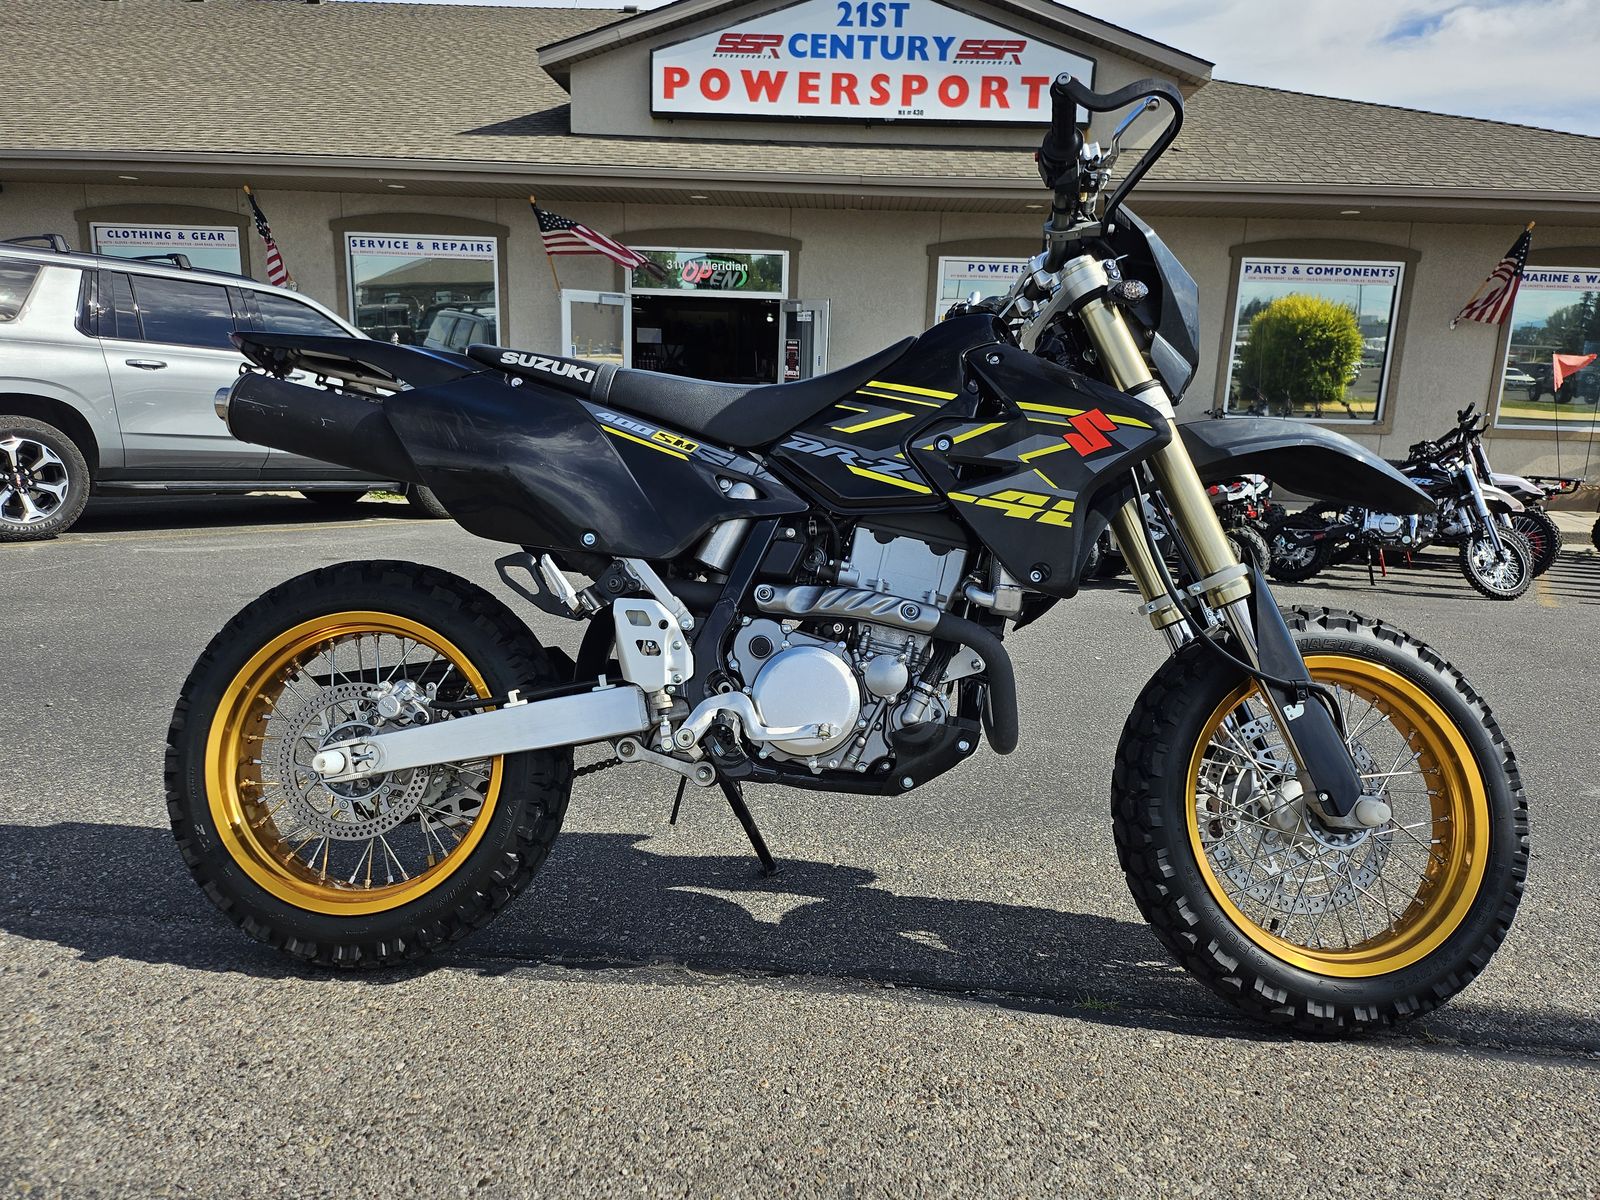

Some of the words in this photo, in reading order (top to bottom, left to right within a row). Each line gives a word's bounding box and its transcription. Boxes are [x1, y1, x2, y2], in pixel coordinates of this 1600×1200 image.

[837, 1, 910, 28] 21ST
[715, 33, 784, 59] SSR
[788, 33, 956, 61] CENTURY
[955, 39, 1027, 65] SSR
[664, 67, 1079, 110] POWERSPORT
[107, 230, 172, 240] CLOTHING
[177, 231, 185, 240] &
[191, 232, 225, 241] GEAR
[352, 239, 409, 250] SERVICE
[416, 241, 424, 250] &
[432, 242, 492, 252] REPAIRS
[666, 260, 684, 270] 310
[703, 260, 748, 271] Meridian
[680, 262, 740, 289] OPEN
[1245, 265, 1287, 275] PARTS
[1292, 266, 1300, 275] &
[1306, 266, 1395, 278] COMPONENTS
[1521, 273, 1569, 283] MARINE
[1572, 275, 1580, 283] &
[1586, 275, 1600, 283] W
[500, 352, 595, 384] SUZUKI
[595, 412, 655, 436] 400
[656, 432, 696, 452] SM
[780, 435, 912, 479] DR-Z
